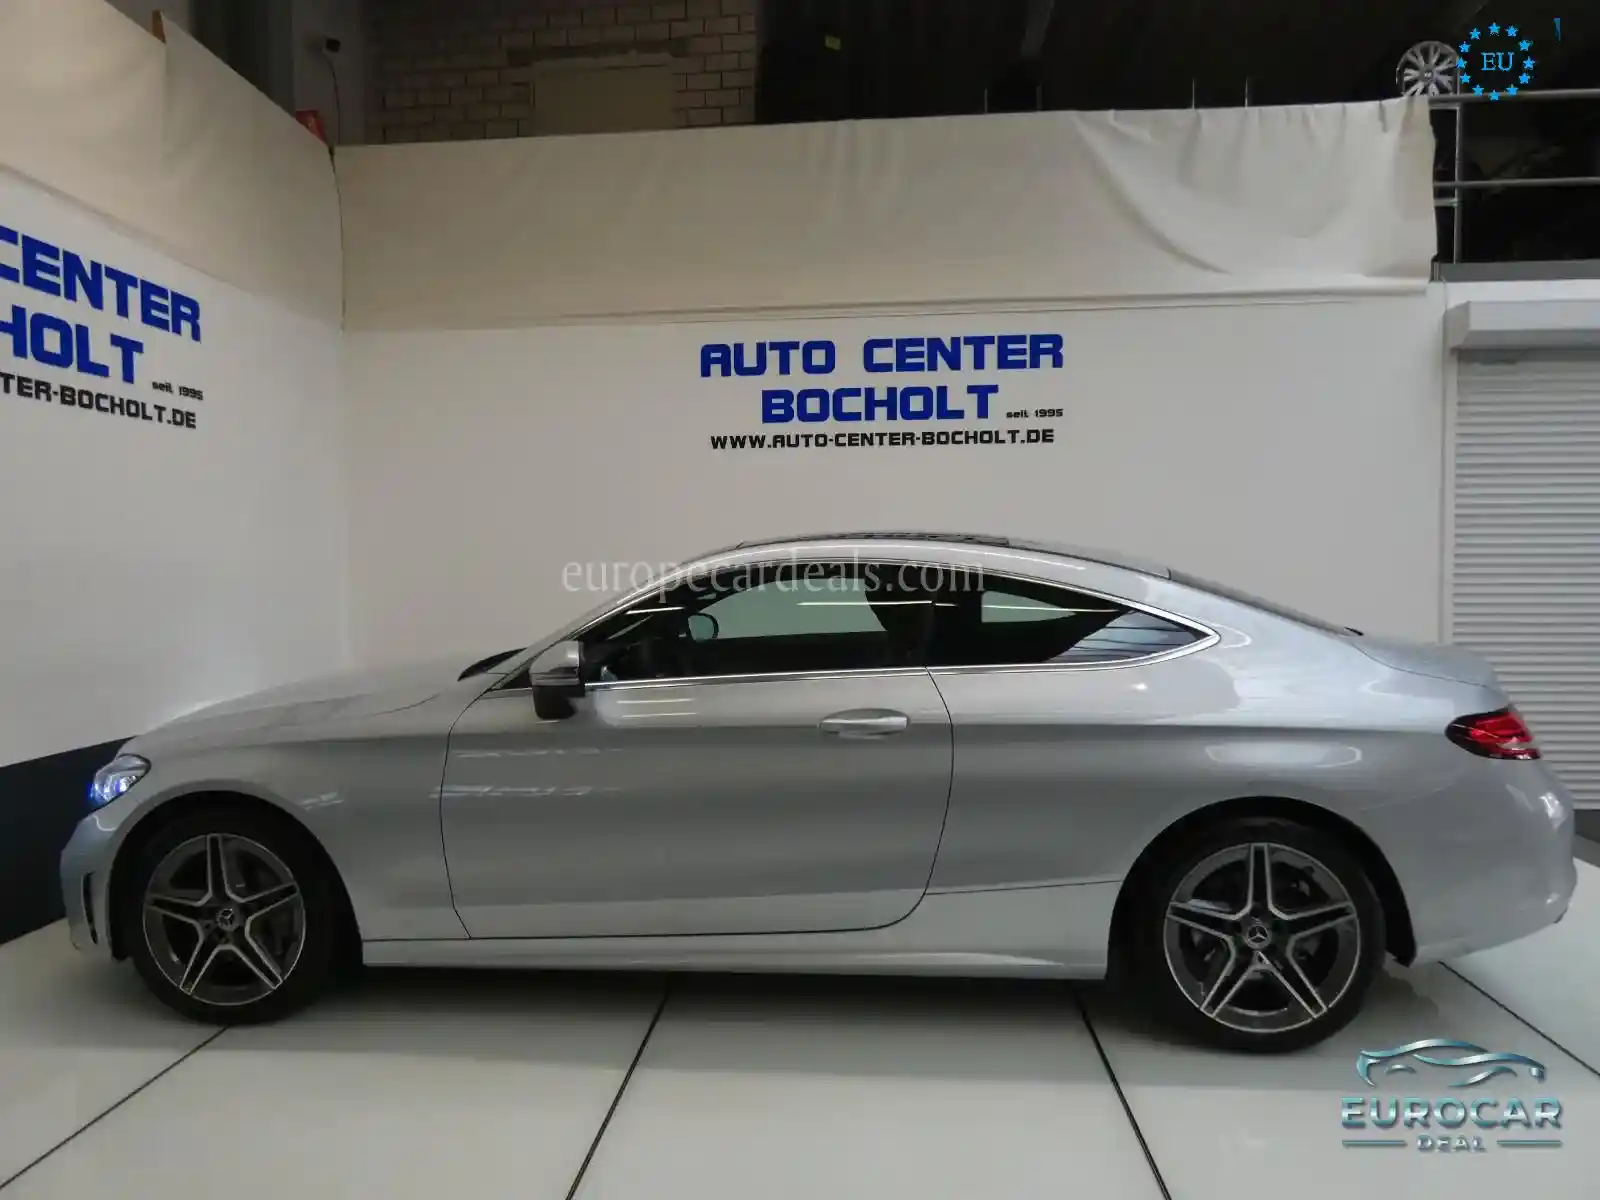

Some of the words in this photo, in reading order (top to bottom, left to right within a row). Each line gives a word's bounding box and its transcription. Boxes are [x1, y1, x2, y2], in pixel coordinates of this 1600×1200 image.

[700, 341, 836, 377] AUTO
[863, 334, 1063, 370] CENTER
[178, 386, 204, 401] 1995
[762, 385, 998, 422] BOCHOLT
[1006, 409, 1029, 418] seit
[1035, 408, 1064, 417] 1995
[711, 429, 1054, 449] WWW.AUTO-CENTER-BOCHOLT.DE
